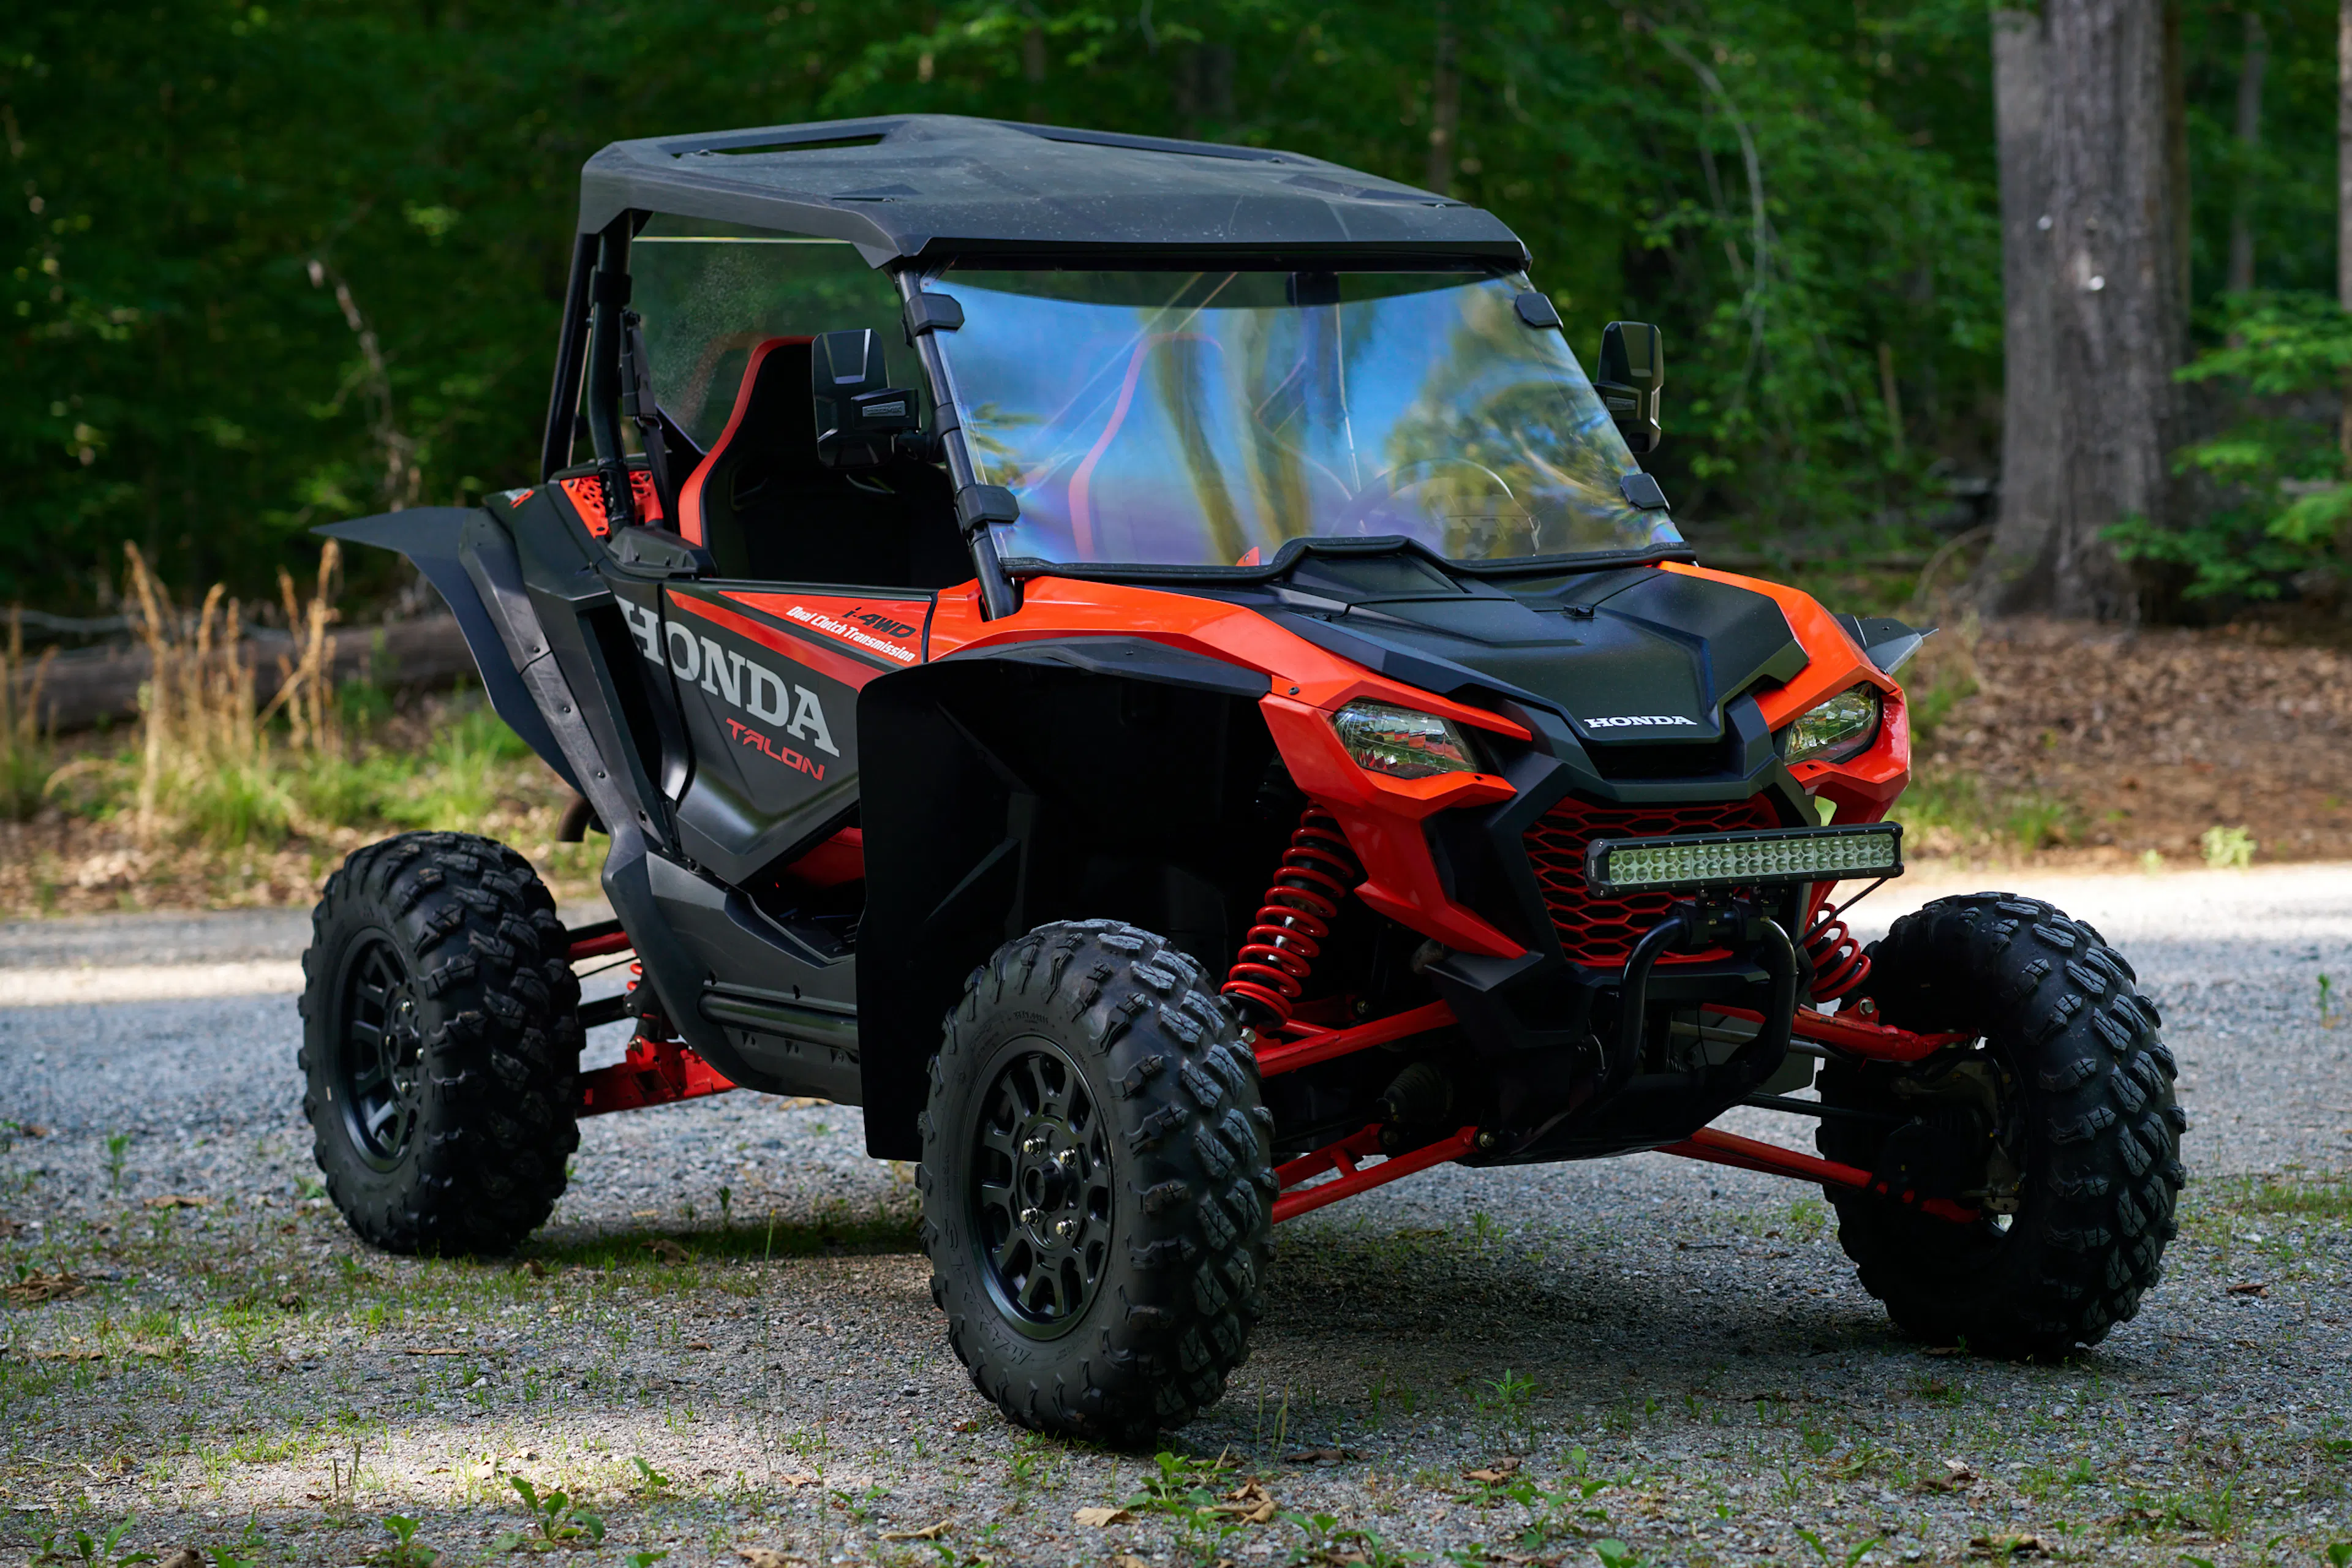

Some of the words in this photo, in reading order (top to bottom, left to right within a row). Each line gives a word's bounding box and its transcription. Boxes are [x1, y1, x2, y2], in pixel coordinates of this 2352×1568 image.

[786, 606, 818, 622] Dual
[810, 614, 848, 635] Clutch
[843, 626, 916, 662] Transmission
[842, 606, 916, 638] i-4WD
[615, 594, 840, 758] HONDA
[726, 717, 825, 782] TALON
[1584, 715, 1698, 728] HONDA
